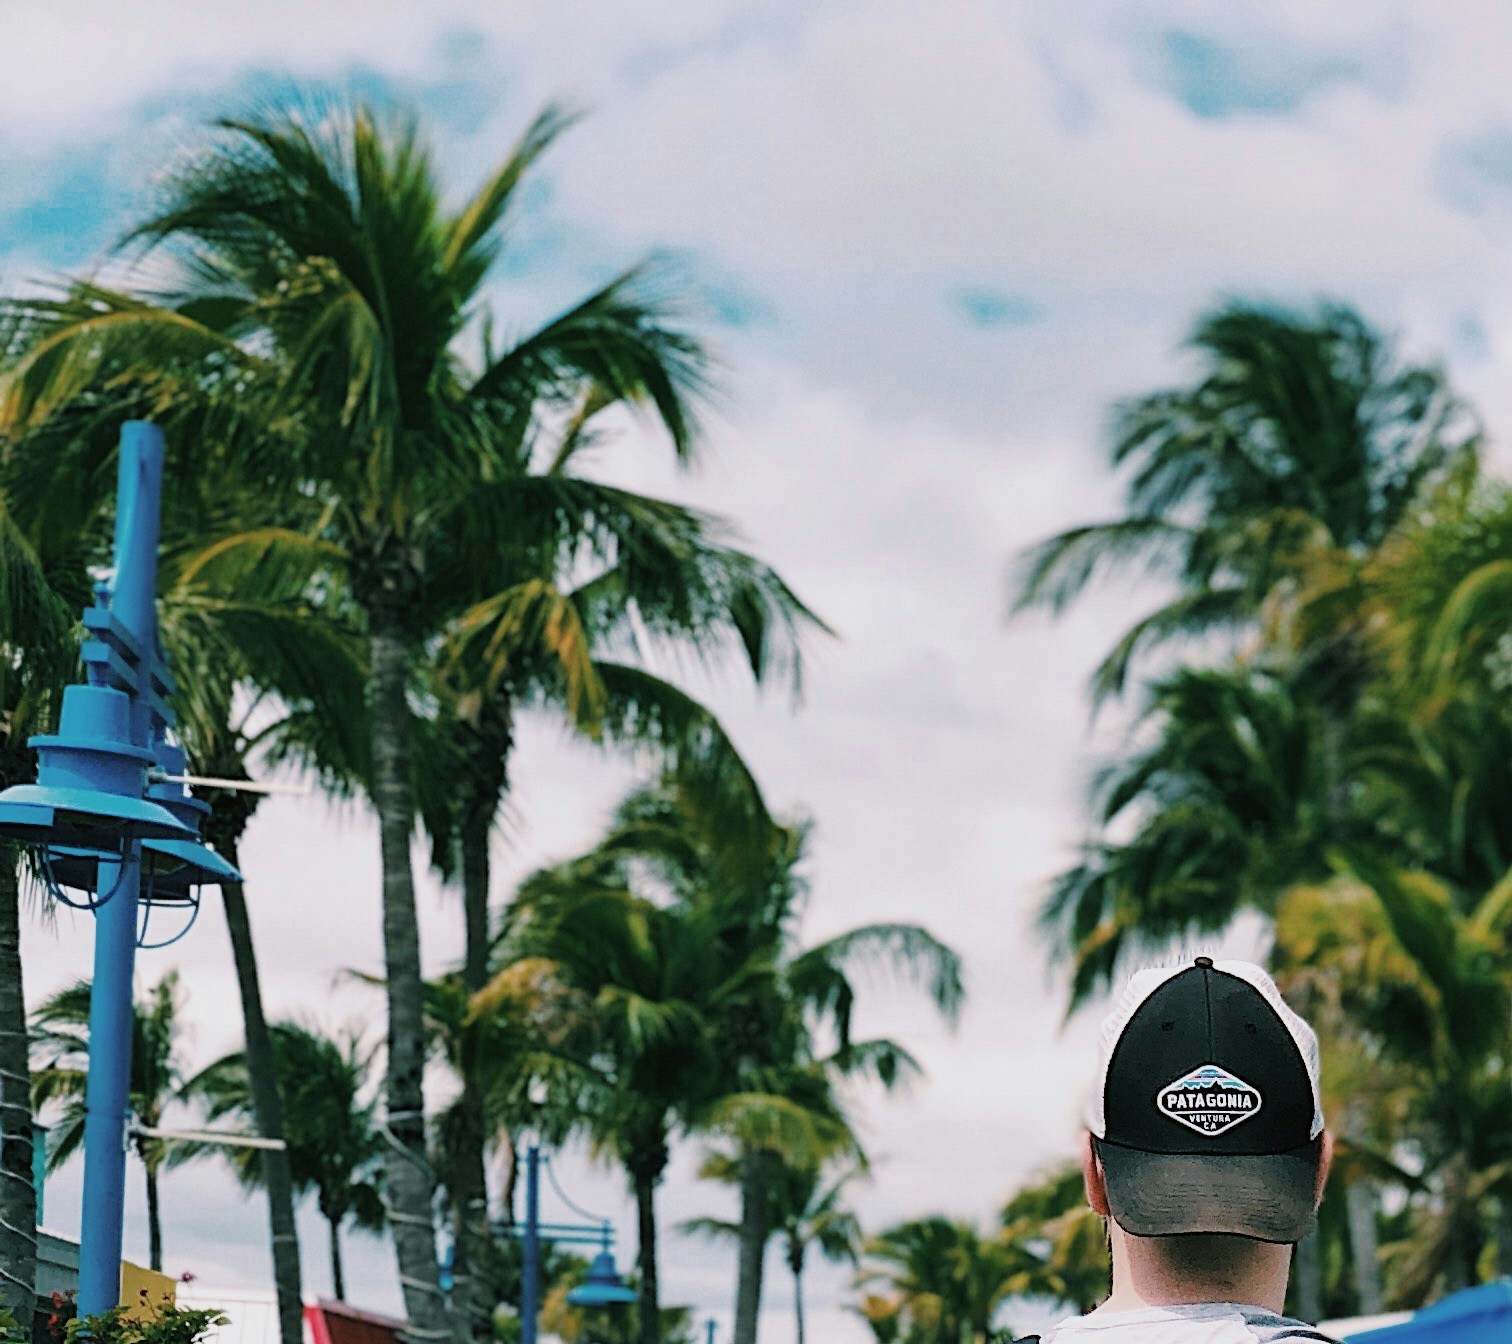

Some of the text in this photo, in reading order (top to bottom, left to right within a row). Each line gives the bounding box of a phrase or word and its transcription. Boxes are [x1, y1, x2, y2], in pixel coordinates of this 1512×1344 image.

[1166, 1093, 1252, 1109] PATAGONIA
[1189, 1114, 1231, 1123] VENTURA
[1203, 1121, 1217, 1131] CA
